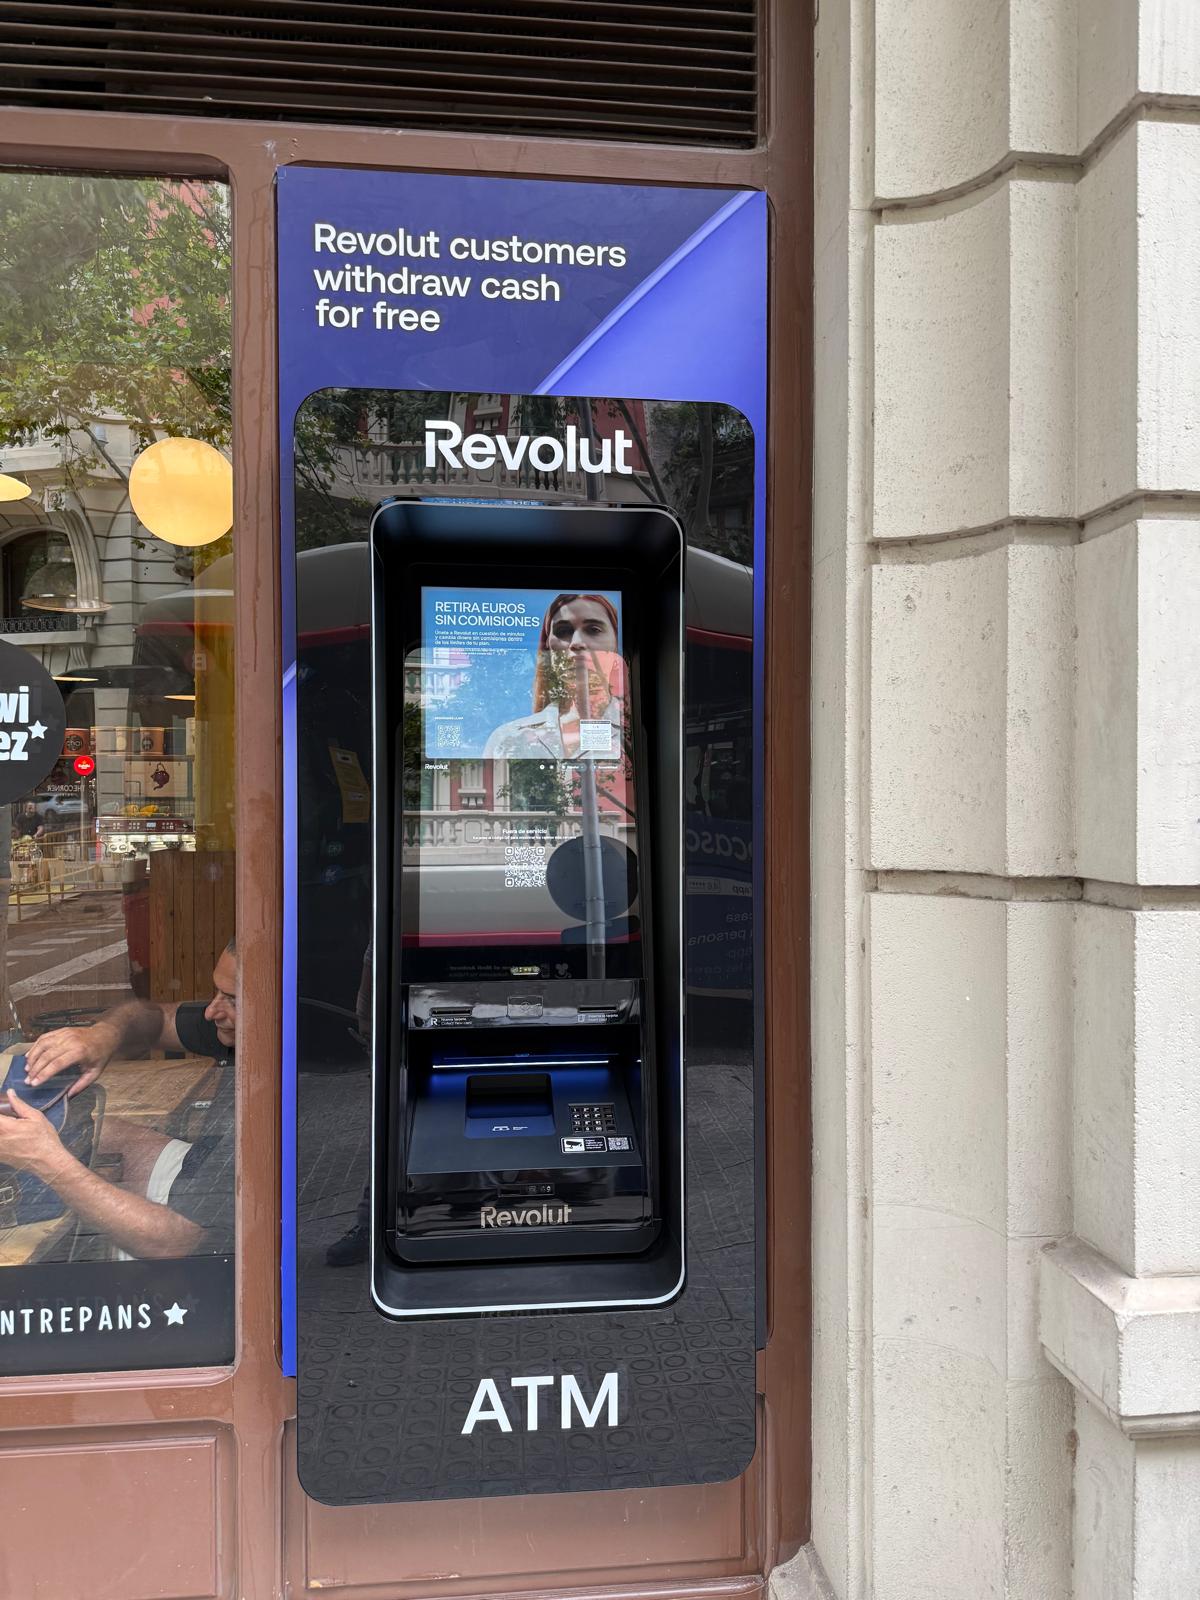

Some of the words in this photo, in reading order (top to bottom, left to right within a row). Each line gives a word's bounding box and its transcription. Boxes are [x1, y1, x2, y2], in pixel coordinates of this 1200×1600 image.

[313, 223, 440, 259] Revolut
[449, 236, 628, 268] customers
[313, 263, 472, 297] withdraw
[480, 273, 561, 302] cash
[314, 298, 364, 329] for
[372, 300, 442, 332] free
[424, 419, 634, 475] Revolut
[434, 615, 457, 626] SIN
[457, 615, 541, 627] COMISIONES
[435, 601, 481, 614] RETIRA
[482, 602, 526, 614] EUROS
[424, 763, 449, 771] Revolut
[480, 1203, 573, 1229] Revolut
[0, 1303, 152, 1336] NTREPANS
[460, 1372, 620, 1435] ATM
